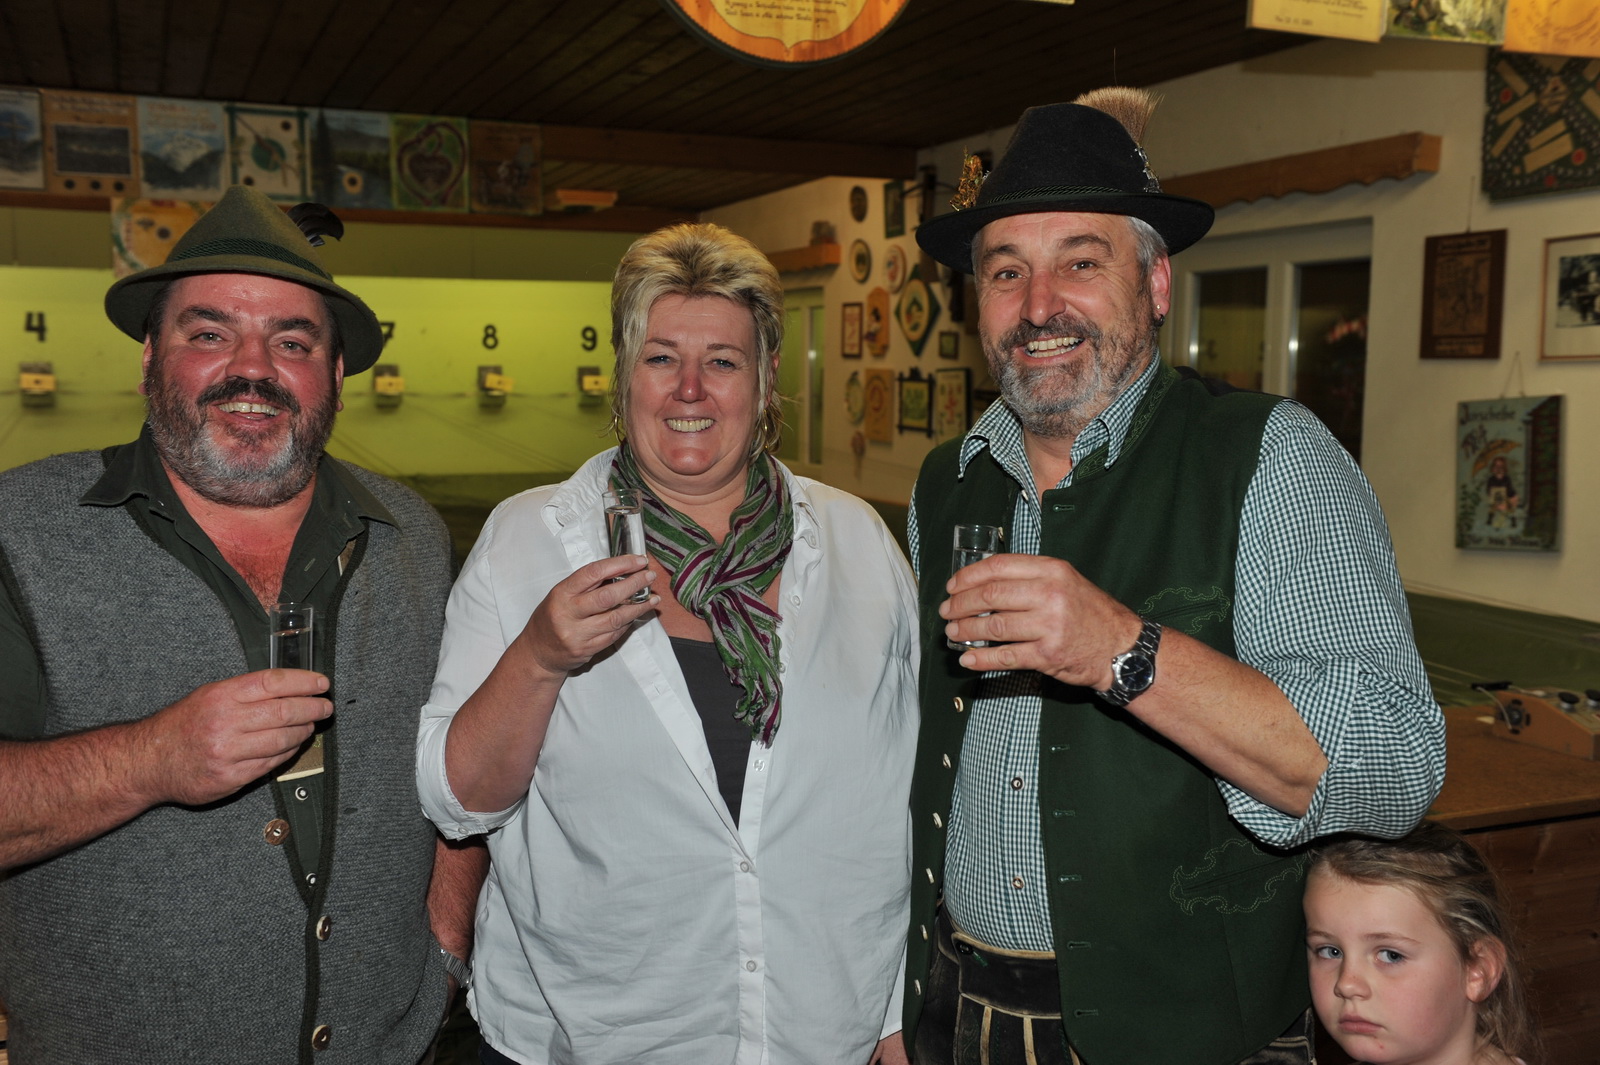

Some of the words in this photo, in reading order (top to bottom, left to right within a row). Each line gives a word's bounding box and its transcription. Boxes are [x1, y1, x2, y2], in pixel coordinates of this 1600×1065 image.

[24, 311, 47, 342] 4
[481, 323, 499, 350] 8
[580, 326, 598, 352] 9
